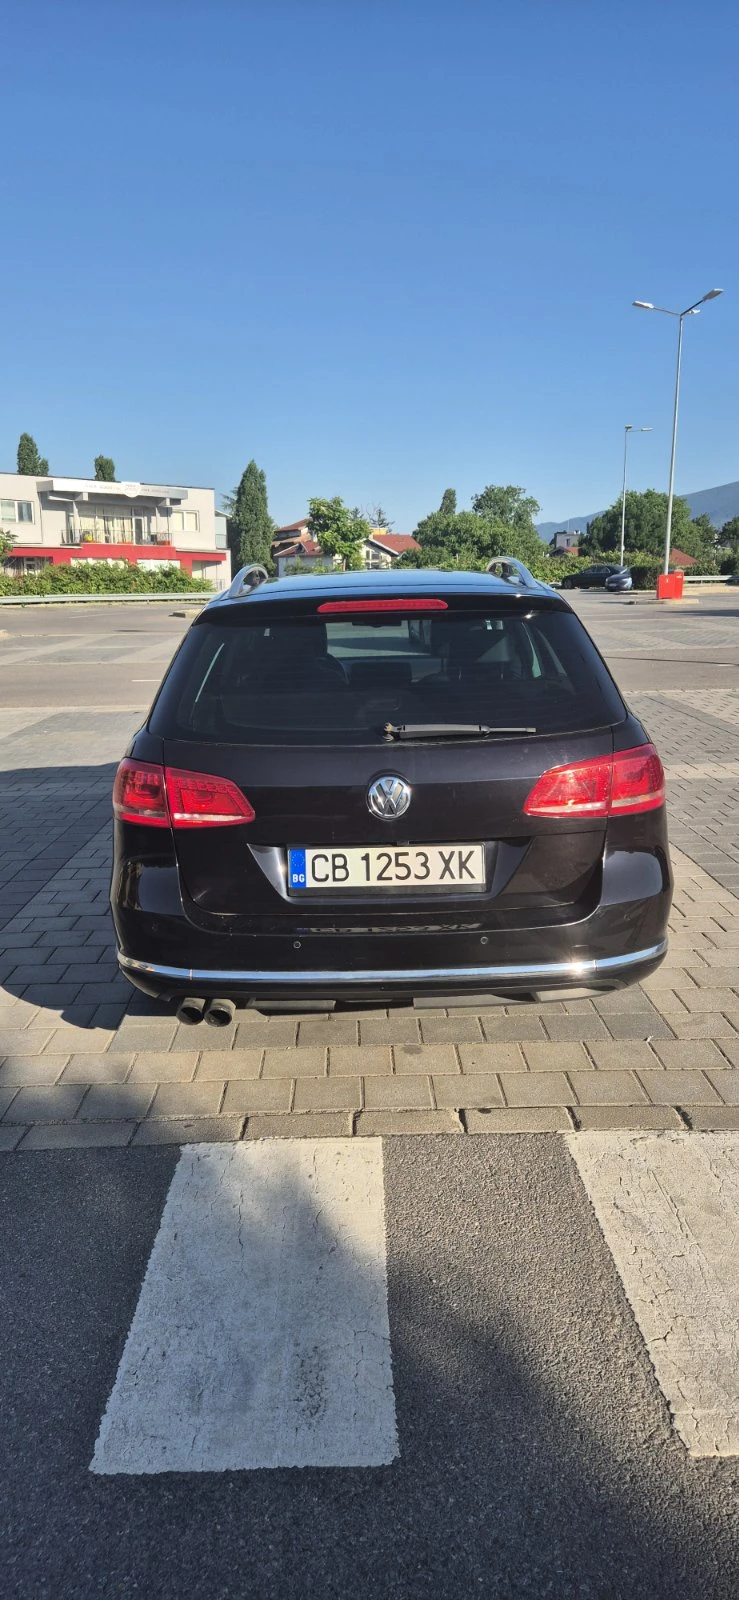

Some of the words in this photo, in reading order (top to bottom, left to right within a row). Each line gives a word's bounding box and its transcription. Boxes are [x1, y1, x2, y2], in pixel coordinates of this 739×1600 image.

[369, 775, 411, 818] VW
[292, 873, 305, 883] BG
[311, 853, 350, 882] CB
[361, 851, 431, 882] 1253
[438, 850, 476, 880] XK
